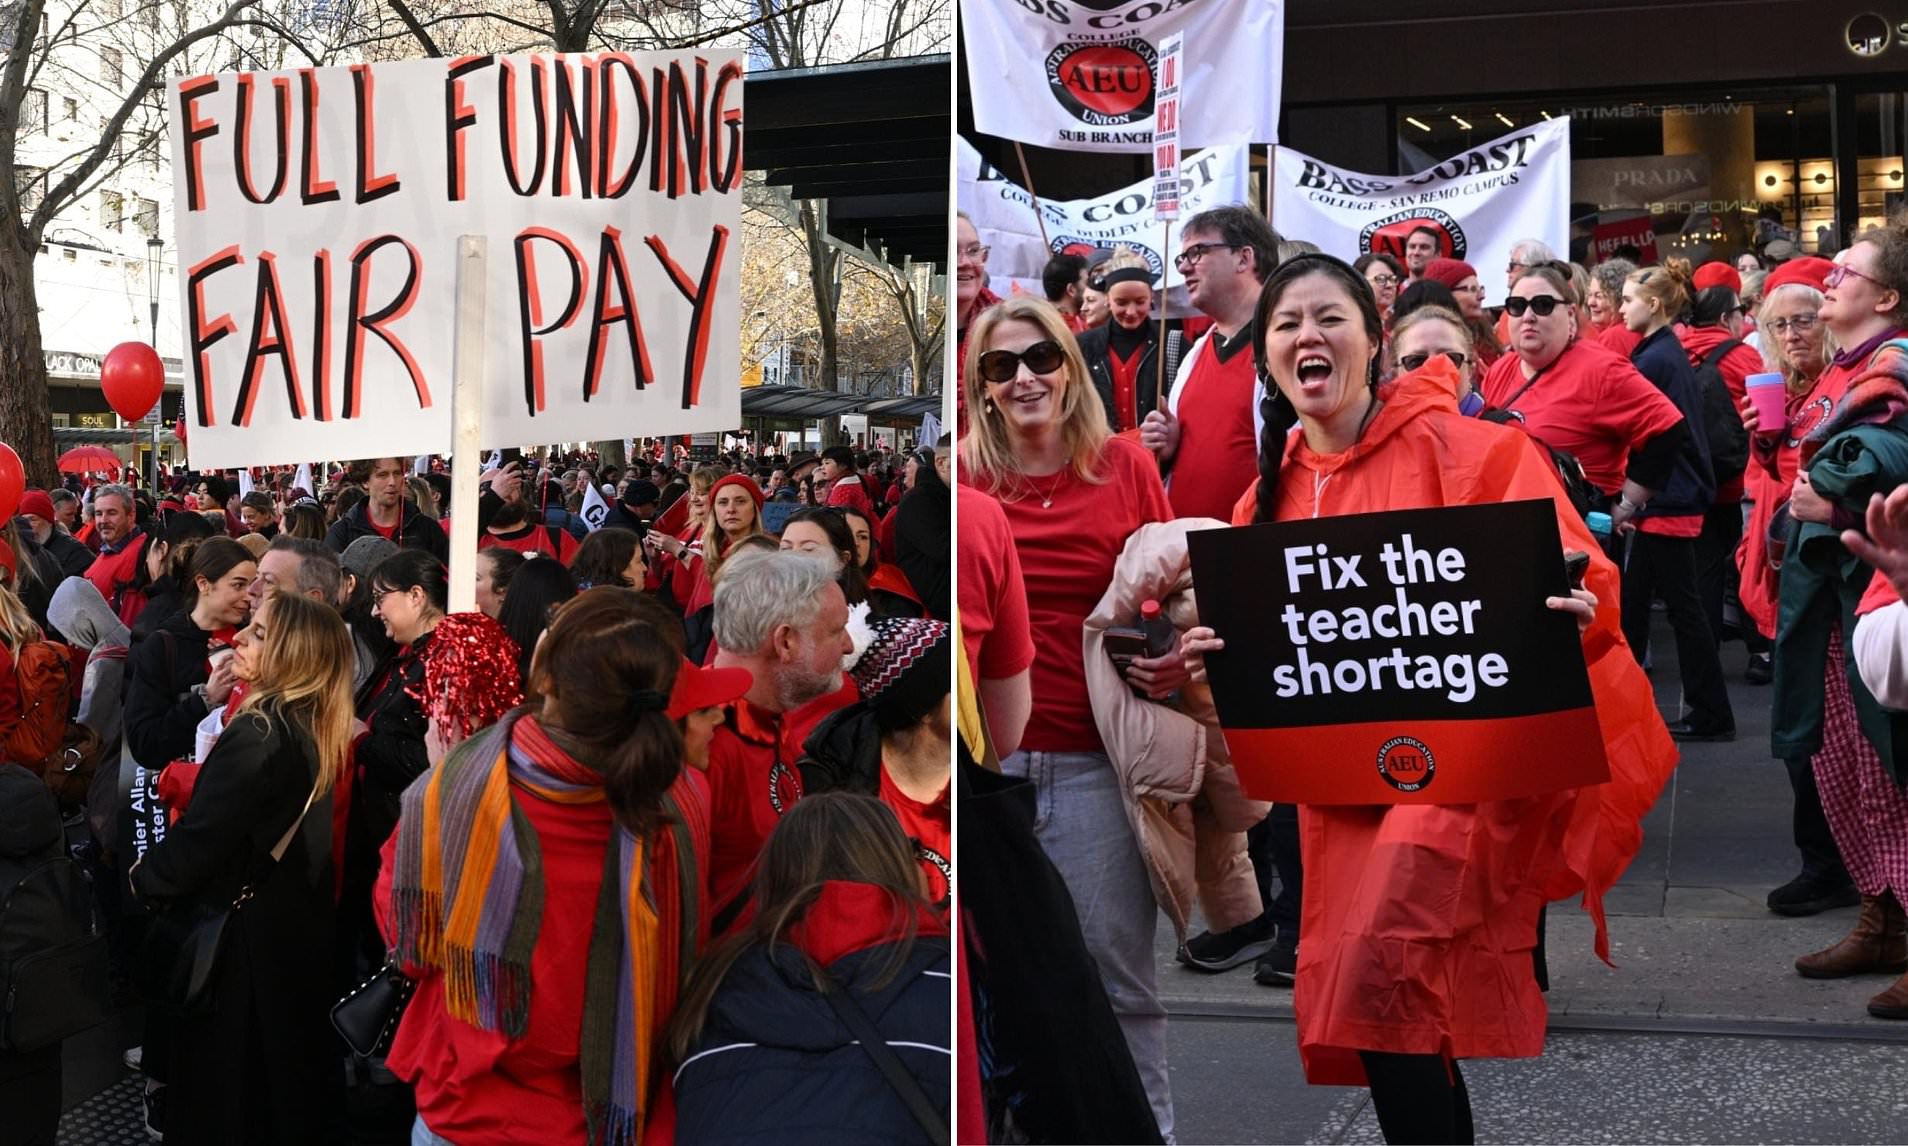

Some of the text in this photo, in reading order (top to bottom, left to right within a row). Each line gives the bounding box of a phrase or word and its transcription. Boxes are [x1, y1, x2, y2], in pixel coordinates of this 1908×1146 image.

[1067, 28, 1141, 41] COLLEGE
[1067, 64, 1147, 93] AEU
[178, 51, 745, 211] FULL FUNDING
[1082, 109, 1130, 125] UNION
[1059, 130, 1086, 142] SUB
[1091, 131, 1153, 144] BRANCH
[1083, 153, 1217, 223] COST
[1309, 191, 1377, 211] COLLEGE
[1389, 194, 1416, 209] SAN
[1419, 187, 1459, 203] REMO
[1463, 172, 1519, 195] CAMPUS
[1613, 168, 1697, 187] PRADA
[1360, 209, 1413, 255] USTRALIAN
[1413, 208, 1465, 252] EDUCATION
[187, 223, 729, 427] FAIR PAY
[43, 355, 72, 370] LACK
[82, 416, 104, 425] SOUL
[1284, 533, 1466, 593] Fix the
[1281, 587, 1482, 645] teacher
[1272, 647, 1509, 703] shortage
[1388, 755, 1424, 771] AEU
[130, 766, 145, 813] Allan
[1398, 782, 1420, 791] UNION
